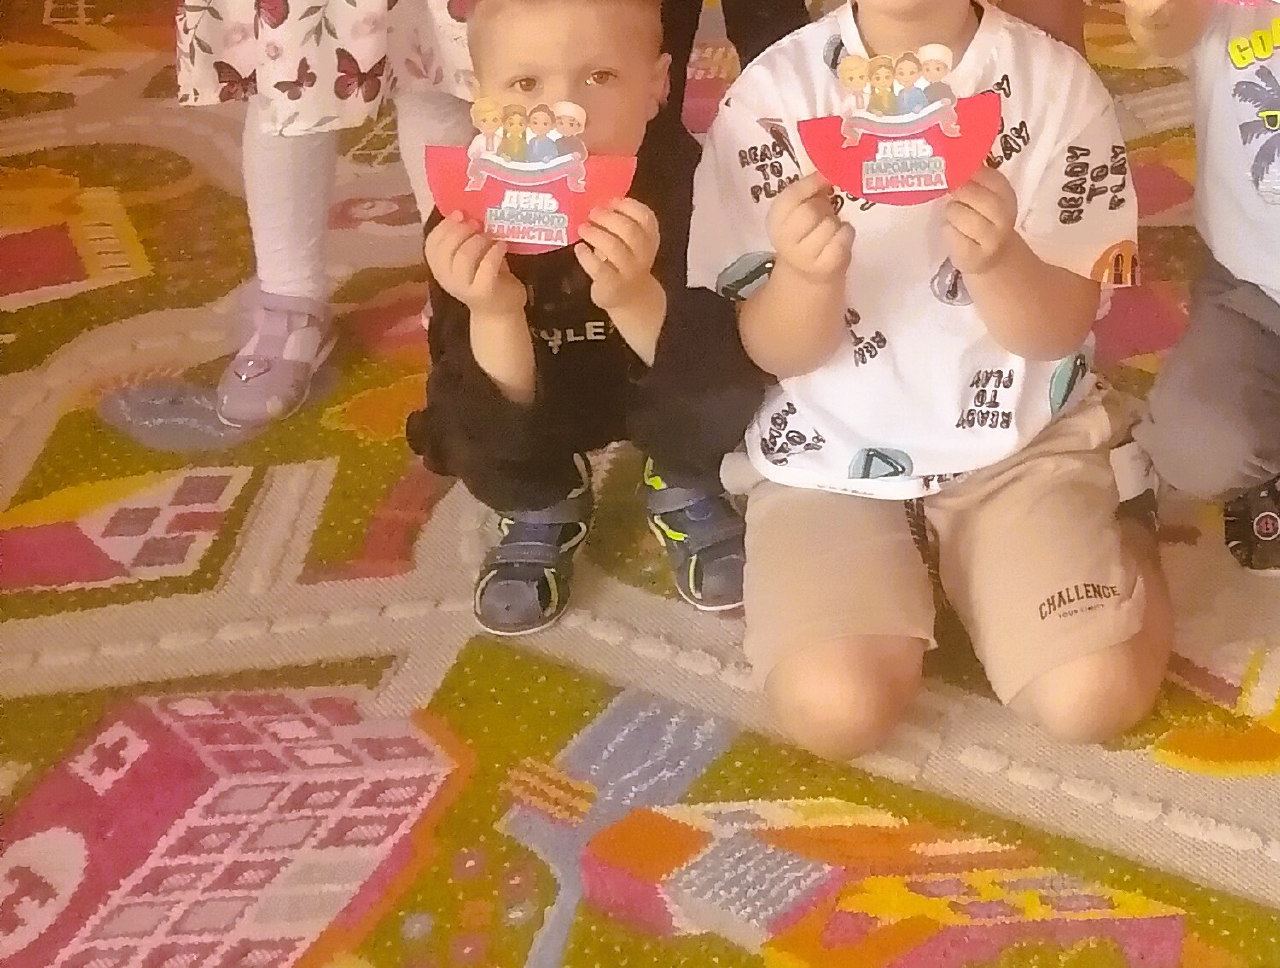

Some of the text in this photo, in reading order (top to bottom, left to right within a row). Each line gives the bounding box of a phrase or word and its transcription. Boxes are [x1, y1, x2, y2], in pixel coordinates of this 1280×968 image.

[877, 139, 933, 159] ДЕНЬ
[756, 160, 782, 181] TO
[865, 173, 944, 190] ЕДИНСТВА
[1057, 145, 1091, 225] READY
[1086, 164, 1108, 204] TO
[502, 190, 558, 212] ДЕНЬ
[970, 368, 1014, 389] PLAY
[974, 389, 1000, 408] TO
[956, 408, 1012, 429] READY
